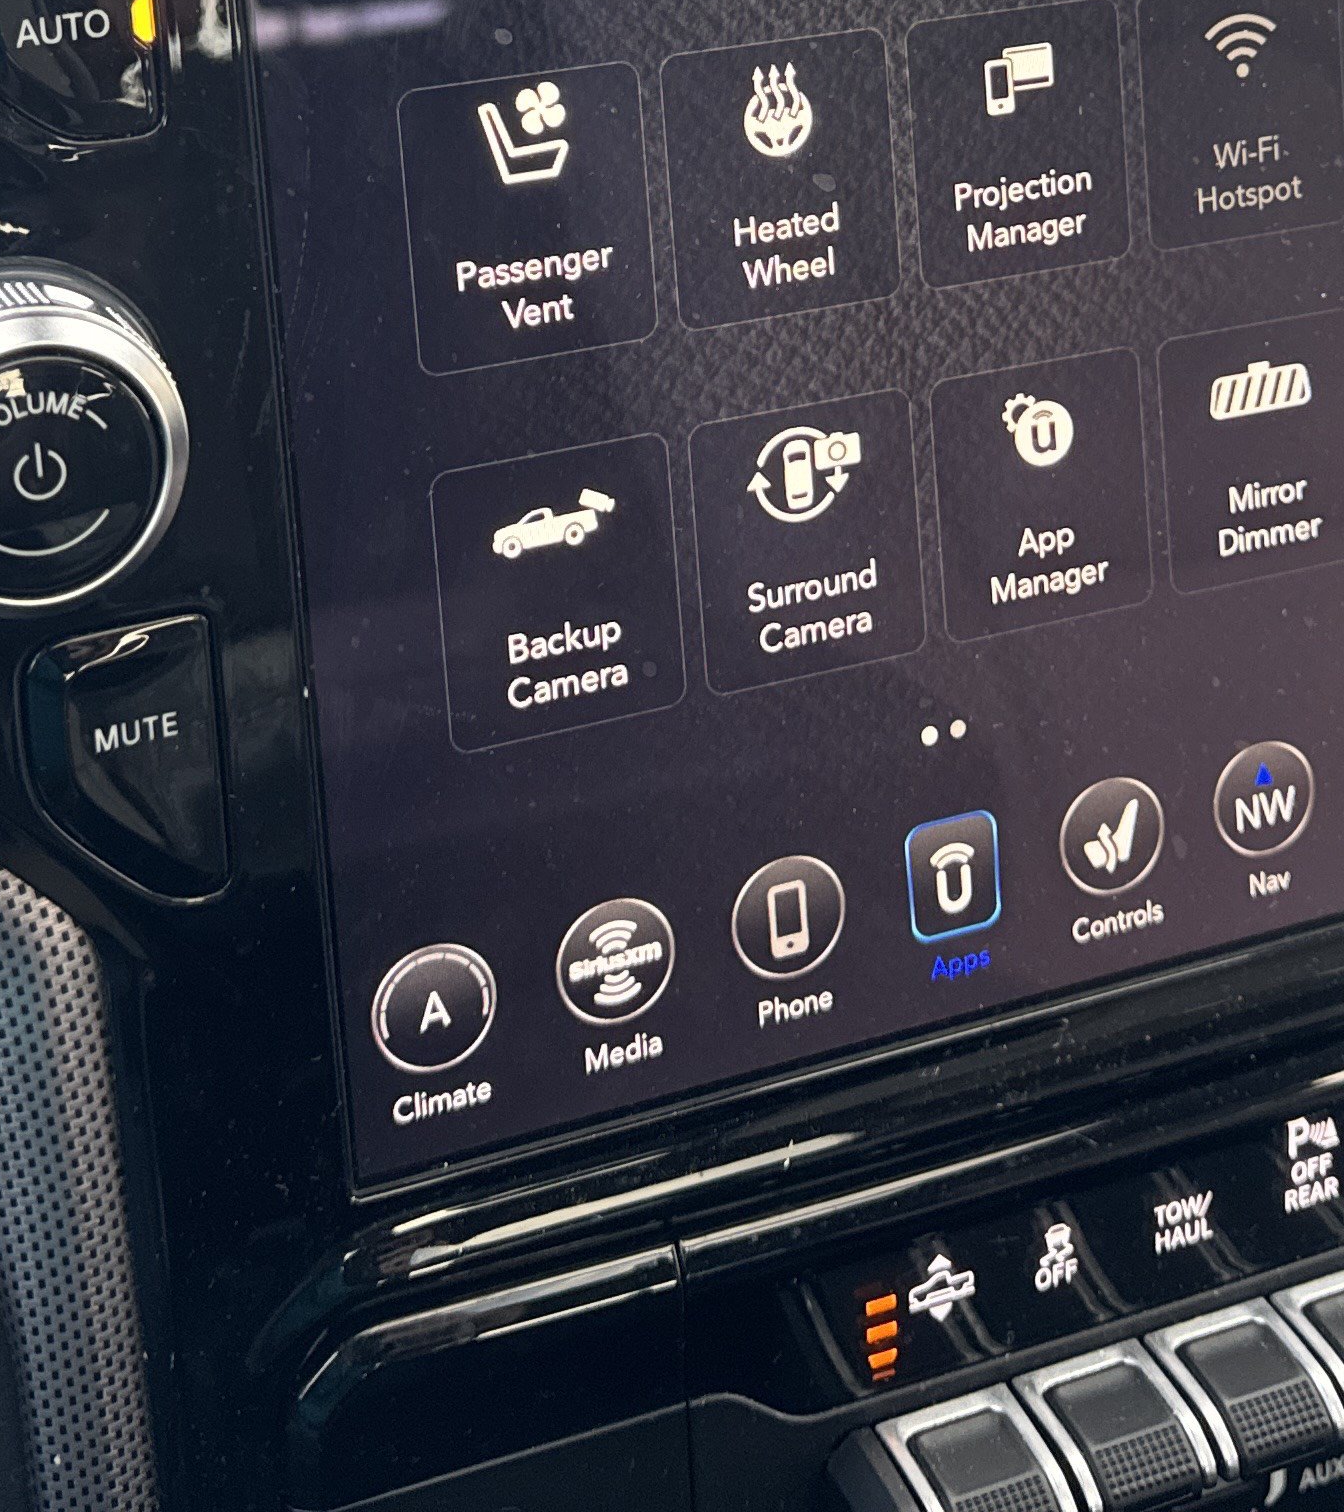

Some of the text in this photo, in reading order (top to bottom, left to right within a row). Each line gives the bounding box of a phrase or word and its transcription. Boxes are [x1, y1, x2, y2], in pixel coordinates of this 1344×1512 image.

[17, 8, 110, 49] AUTO
[1213, 134, 1280, 170] Wi-Fi
[954, 168, 1092, 211] Projection
[1197, 175, 1304, 214] Hotspot
[734, 202, 840, 247] Heated
[966, 210, 1087, 253] Manager
[456, 243, 613, 292] Passenger
[742, 246, 836, 289] Wheel
[501, 292, 574, 329] Vent
[1228, 479, 1308, 514] Mirror
[1018, 524, 1075, 558] App
[1218, 514, 1323, 558] Dimmer
[747, 558, 878, 612] Surround
[990, 559, 1109, 604] Manager
[507, 619, 622, 664] Backup
[759, 609, 874, 653] Camera
[507, 662, 629, 708] Camera
[94, 710, 179, 754] MUTE
[1235, 784, 1295, 834] NW
[1249, 868, 1292, 898] Nav
[1071, 899, 1165, 944] Controls
[930, 947, 992, 982] Apps
[757, 988, 834, 1028] Phone
[584, 1032, 664, 1075] Media
[392, 1080, 492, 1126] Climate
[1291, 1152, 1335, 1184] OFF
[1153, 1190, 1213, 1226] TOW/
[1285, 1176, 1339, 1213] REAR
[1154, 1217, 1214, 1254] HAUL
[1035, 1257, 1077, 1289] OFF
